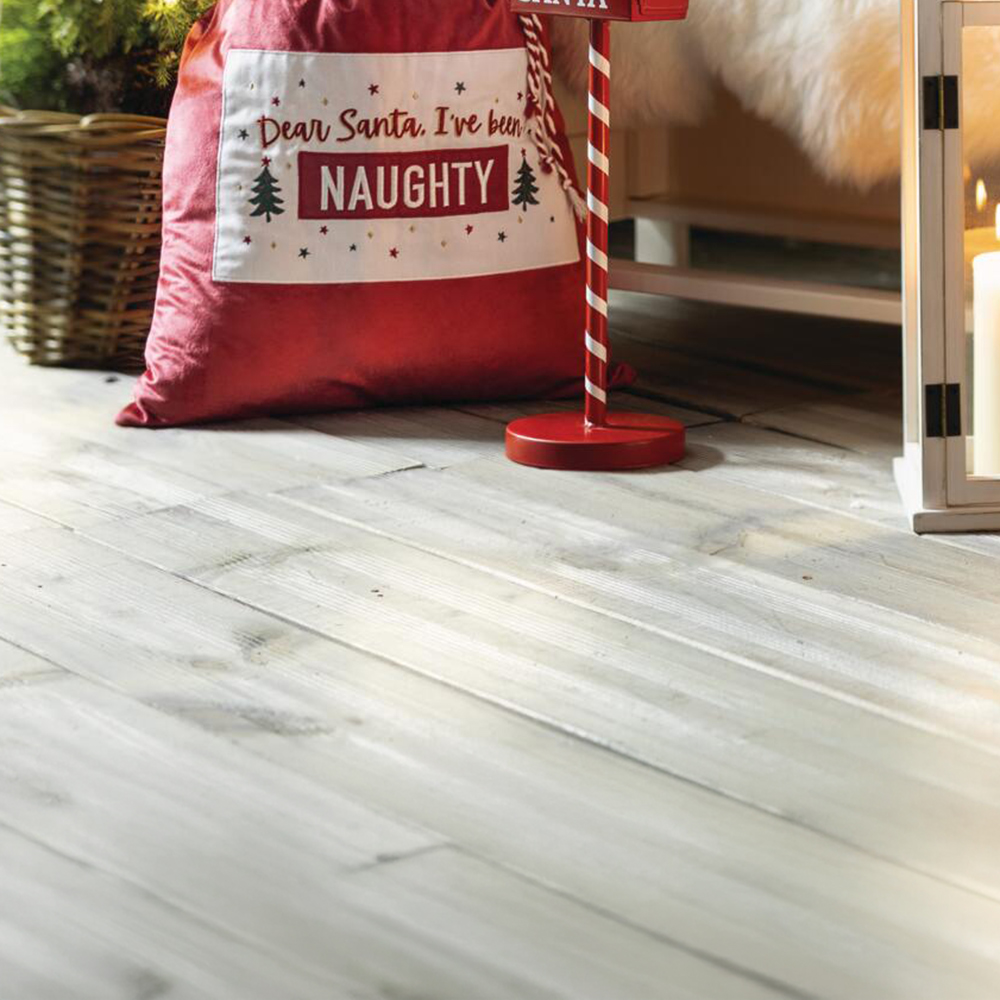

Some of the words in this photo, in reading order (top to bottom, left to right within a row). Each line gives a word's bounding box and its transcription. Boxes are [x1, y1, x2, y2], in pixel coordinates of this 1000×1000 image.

[257, 114, 330, 148] Dear
[434, 106, 482, 136] I've
[320, 159, 495, 211] NAUGHTY
